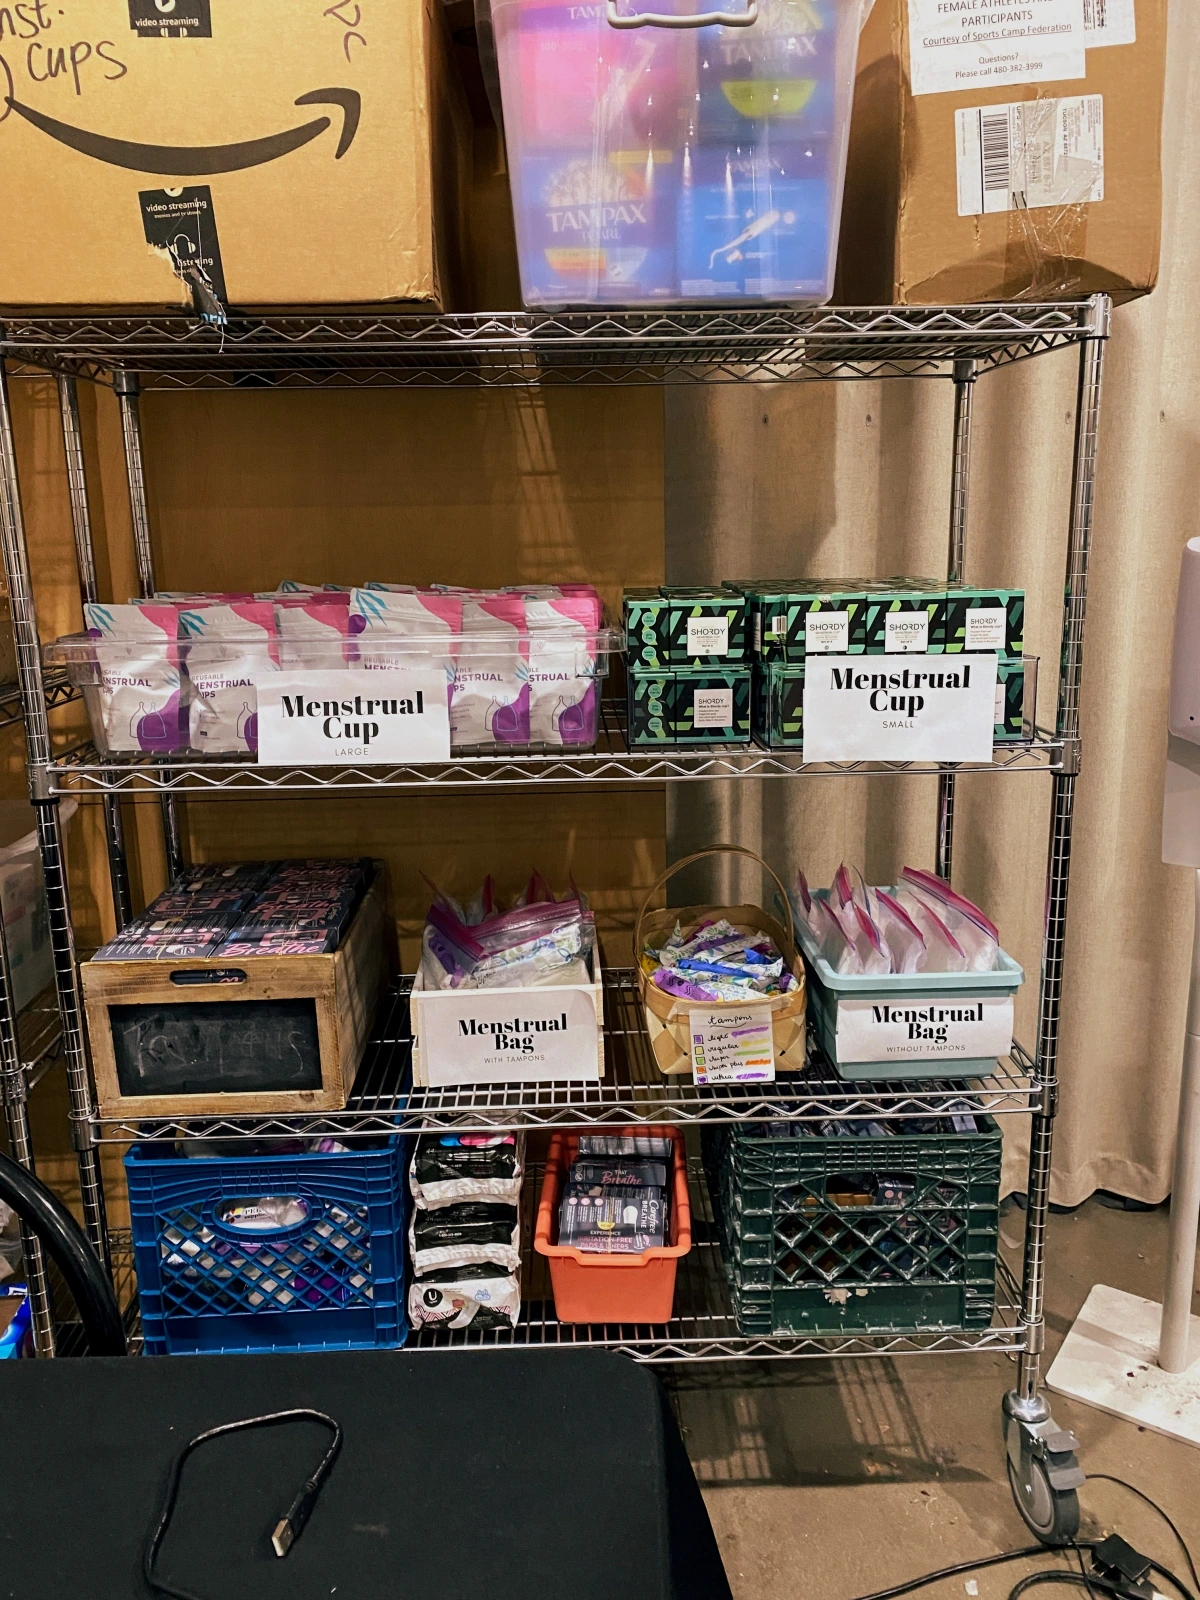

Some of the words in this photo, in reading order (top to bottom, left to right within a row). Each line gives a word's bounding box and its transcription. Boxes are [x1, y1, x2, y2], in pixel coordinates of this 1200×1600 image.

[937, 1, 978, 14] FEMALE
[135, 16, 157, 27] video
[159, 16, 199, 27] streaming
[961, 9, 1033, 28] PARTICIPANTS
[922, 34, 961, 47] Courtesy
[961, 31, 971, 42] of
[972, 28, 1000, 42] Sports
[1001, 27, 1026, 39] Camp
[1027, 22, 1072, 36] Federation
[978, 52, 1019, 65] Questions?
[955, 69, 979, 79] Please
[979, 67, 992, 76] call
[993, 62, 1043, 74] 480-382-3999
[146, 203, 168, 213] video
[168, 200, 208, 211] streaming
[545, 203, 647, 233] TAMPAX
[809, 623, 846, 631] SHORDY
[889, 623, 926, 631] SHORDY
[970, 617, 998, 625] SHORDY
[690, 628, 726, 636] SHORDY
[191, 673, 224, 681] REUSABLE
[830, 665, 971, 690] Menstrual
[280, 690, 425, 718] Menstrual
[869, 689, 925, 718] Cup
[323, 717, 379, 745] Cup
[882, 720, 914, 729] SMALL
[335, 747, 369, 757] LARGE
[219, 942, 320, 957] Breathe
[707, 1015, 753, 1025] tampons
[870, 1003, 984, 1024] Menstrual
[458, 1013, 568, 1037] Menstrual
[907, 1023, 949, 1045] Bag
[494, 1033, 534, 1055] Bag
[886, 1045, 923, 1053] WITHOUT
[926, 1044, 966, 1052] TAMPONS
[484, 1057, 503, 1065] WITH
[506, 1054, 545, 1063] TAMPONS
[600, 1171, 643, 1185] Breathe
[640, 1200, 648, 1229] BREATHE
[649, 1199, 660, 1234] Carefree
[428, 1291, 438, 1301] U
